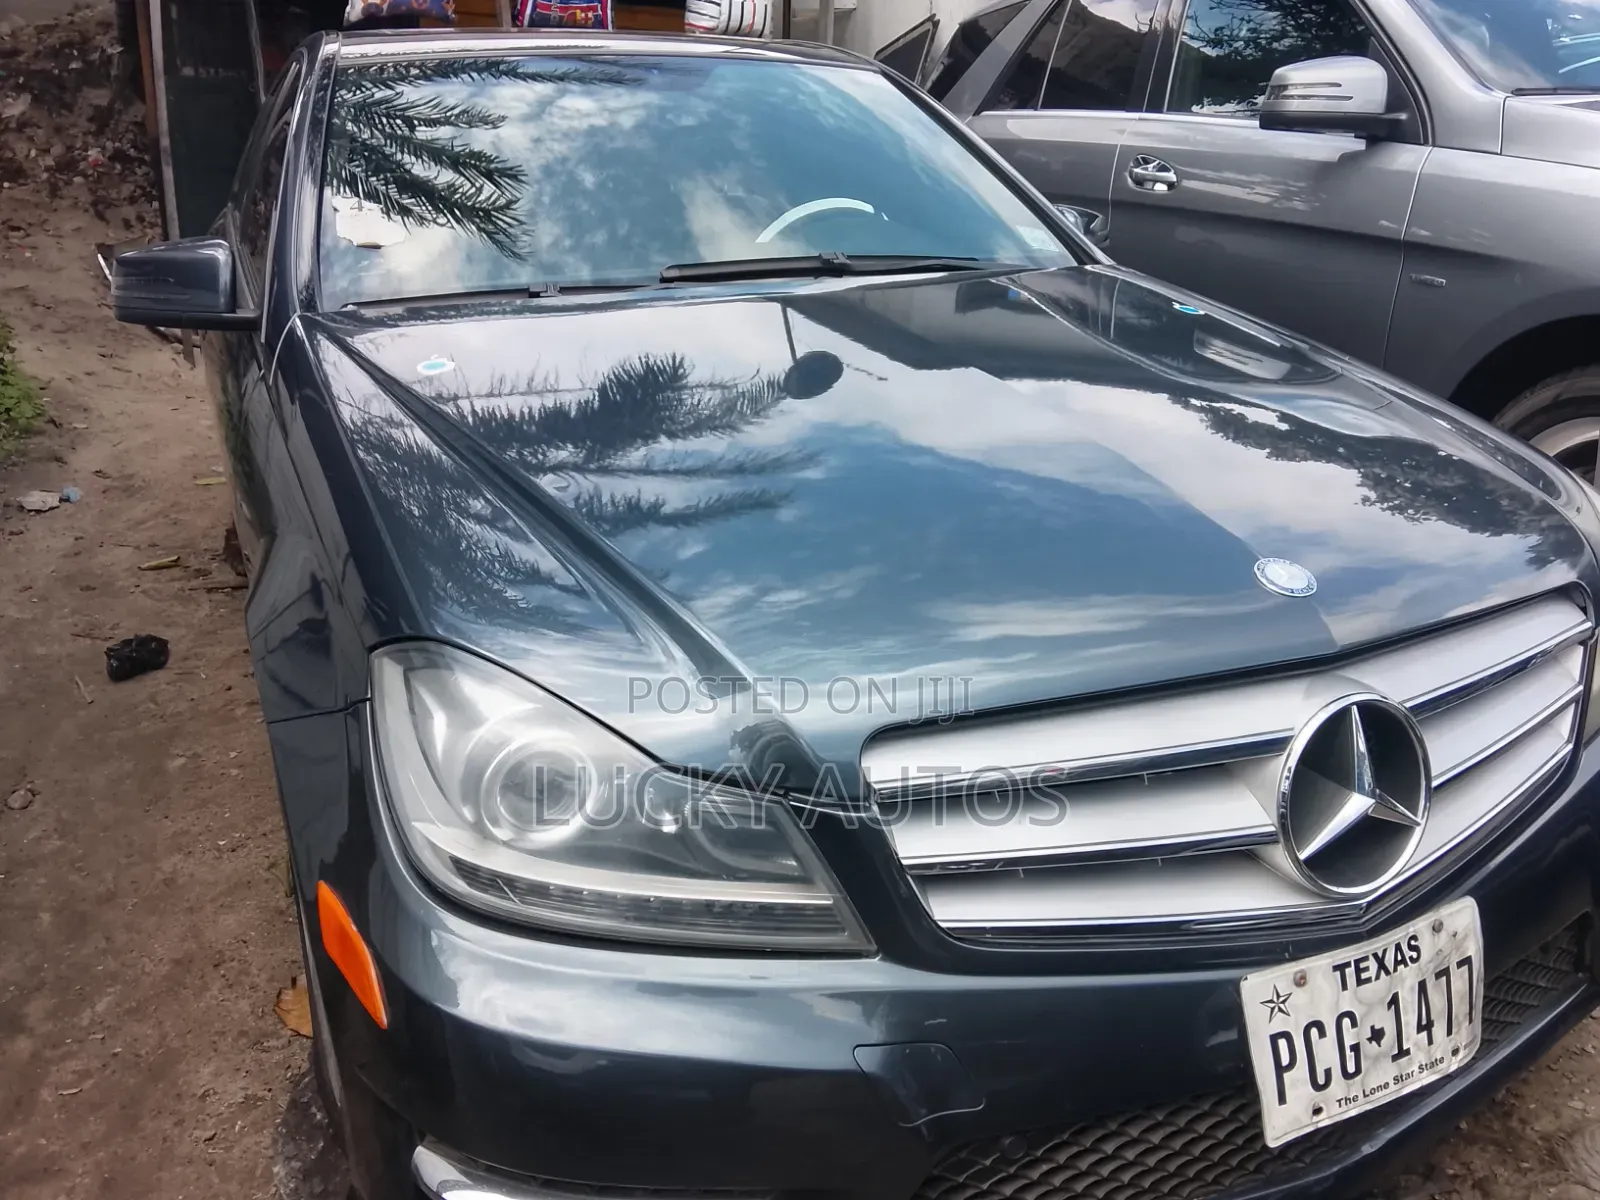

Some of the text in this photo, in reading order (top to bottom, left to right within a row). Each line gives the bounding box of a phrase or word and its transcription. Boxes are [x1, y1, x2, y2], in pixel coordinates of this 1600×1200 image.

[1332, 934, 1422, 992] TEXAS
[1269, 955, 1474, 1106] PCG 1477
[1336, 1055, 1445, 1108] The Lone Star State
